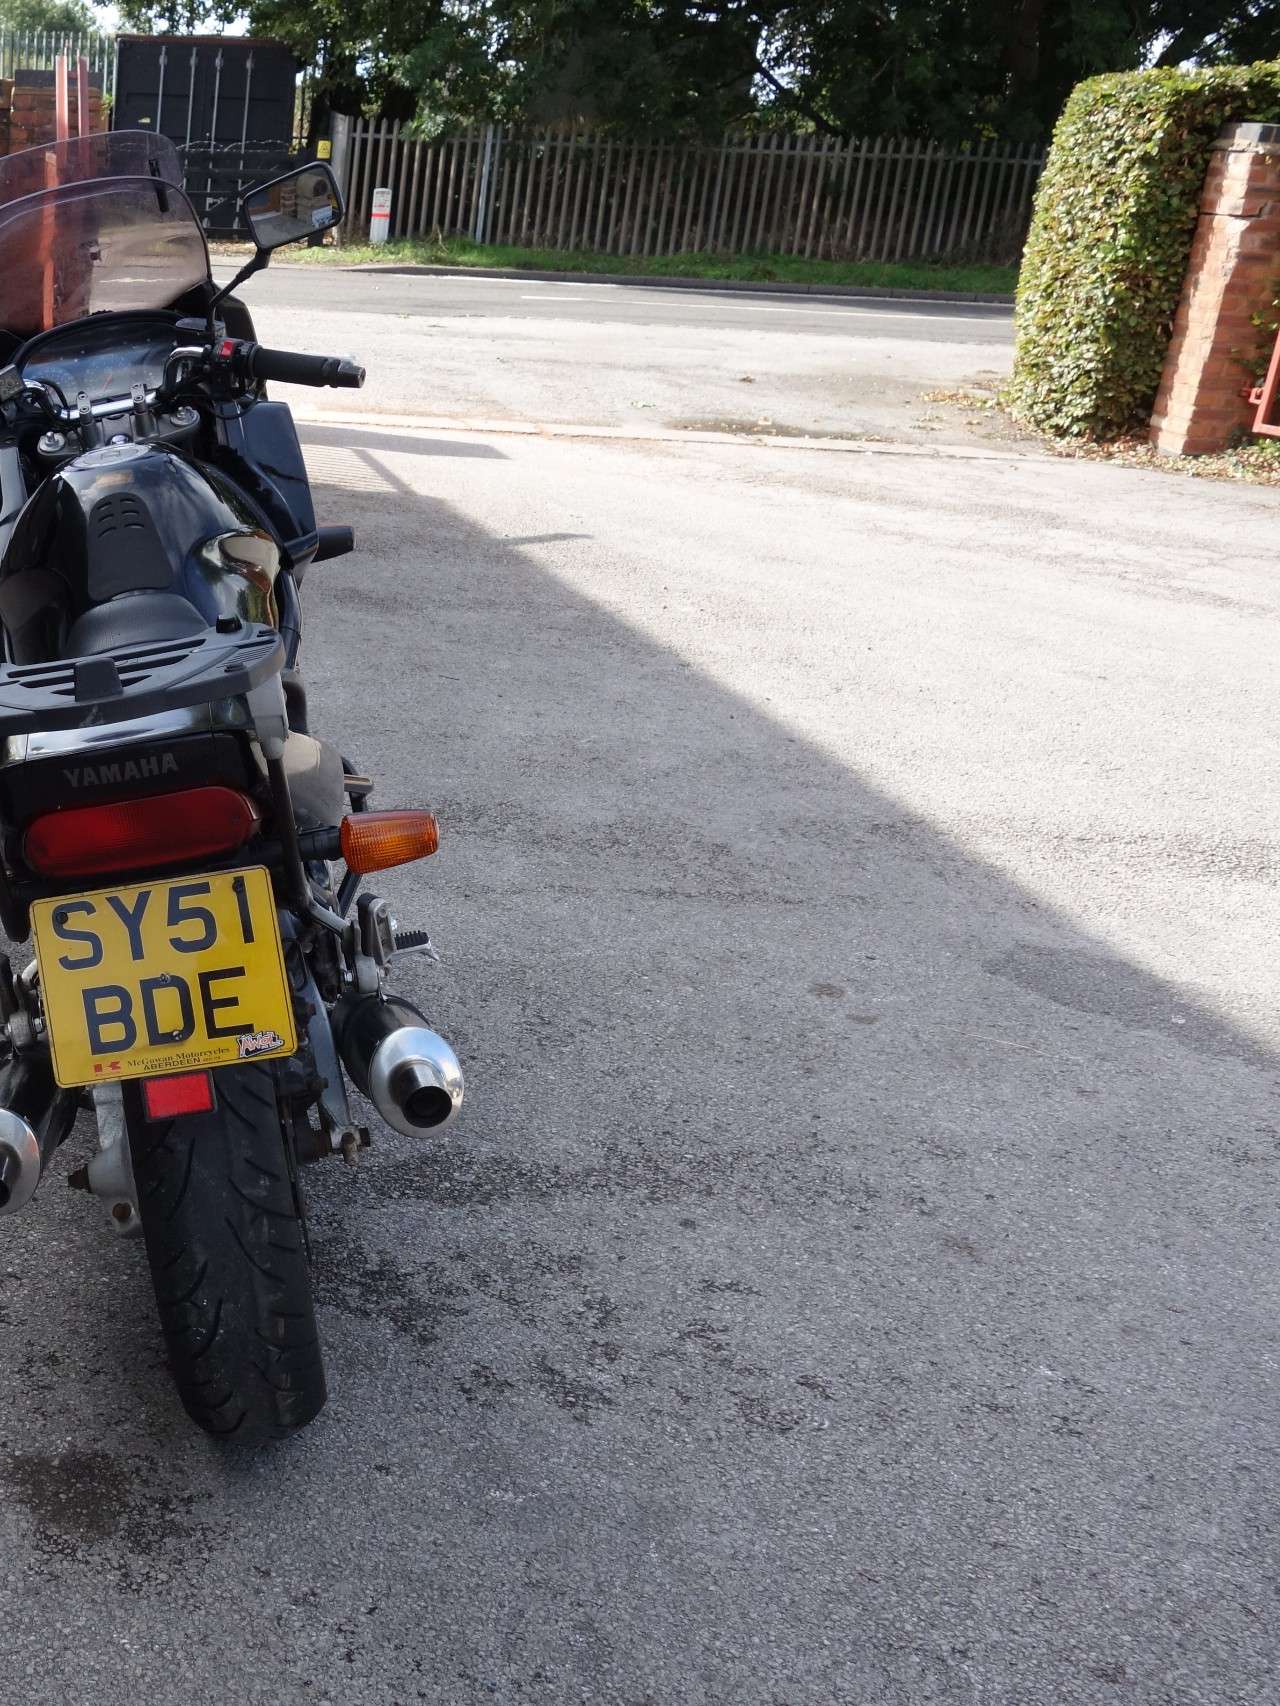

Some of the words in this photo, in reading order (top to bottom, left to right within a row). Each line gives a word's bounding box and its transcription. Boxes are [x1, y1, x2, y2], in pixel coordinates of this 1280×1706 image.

[61, 751, 179, 789] YAMAHA
[51, 876, 256, 971] SY51
[81, 966, 255, 1057] BDE
[143, 1057, 201, 1071] ABERDEEN
[176, 1047, 231, 1060] Motorcycles
